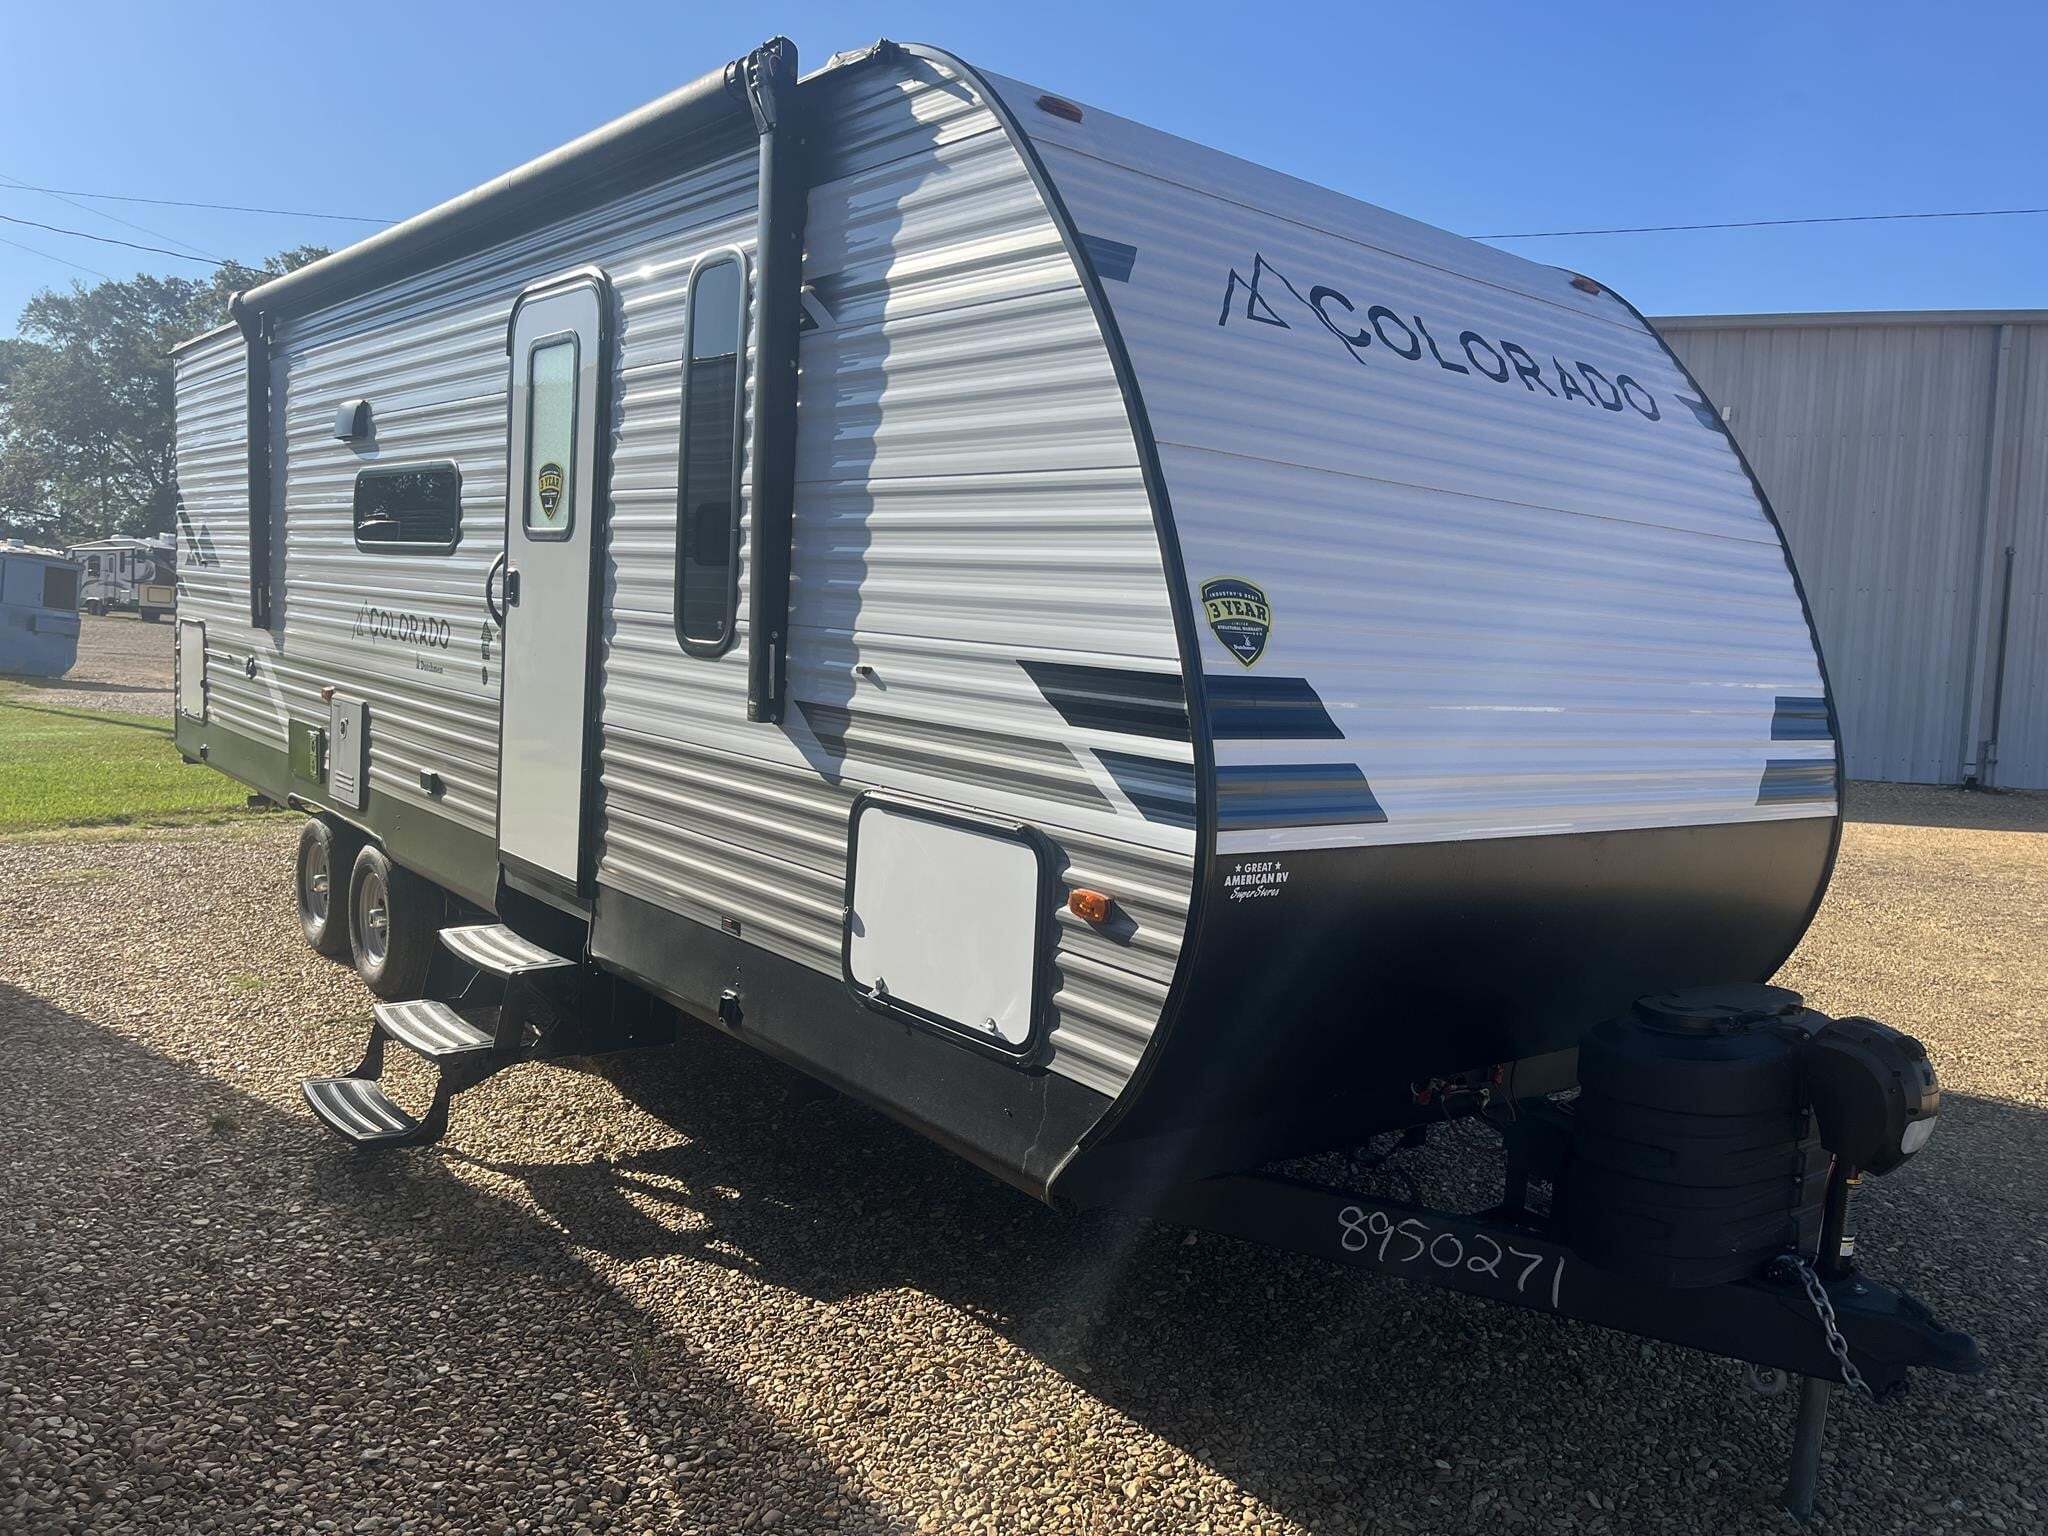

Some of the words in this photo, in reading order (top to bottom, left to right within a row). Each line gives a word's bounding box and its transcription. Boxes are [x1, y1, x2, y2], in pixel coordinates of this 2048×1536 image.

[1309, 284, 1661, 422] COLORADO
[1208, 602, 1221, 619] 3
[1221, 600, 1267, 622] YEAR
[369, 607, 451, 650] COLORADO
[1224, 873, 1275, 887] AMERICAN
[1275, 871, 1289, 883] RV
[1244, 862, 1273, 873] GREAT
[1337, 1205, 1565, 1309] 8950271
